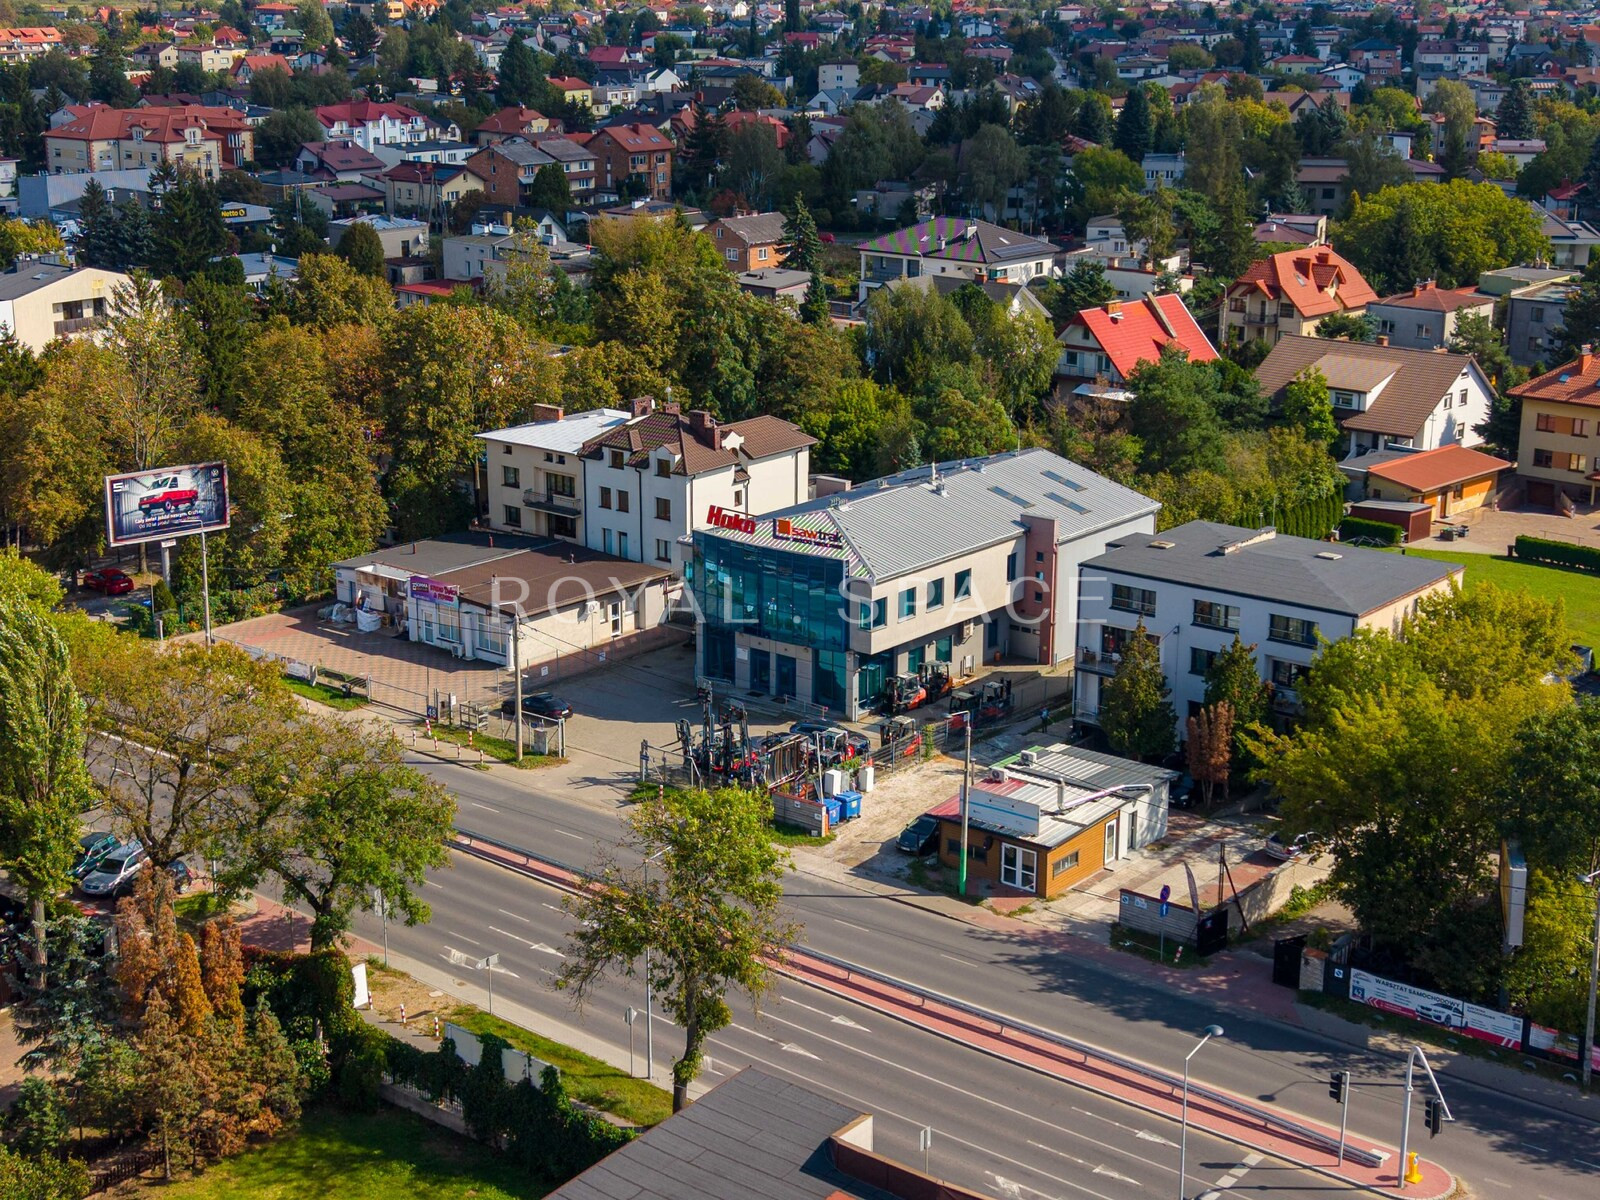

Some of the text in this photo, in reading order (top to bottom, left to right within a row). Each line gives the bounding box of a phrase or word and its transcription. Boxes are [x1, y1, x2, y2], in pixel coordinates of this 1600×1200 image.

[706, 505, 756, 535] Hako
[792, 528, 842, 542] sawtrak
[428, 708, 436, 717] 48
[1375, 978, 1407, 993] WARSZTAT
[1408, 989, 1460, 1007] SAMOCHODOWY
